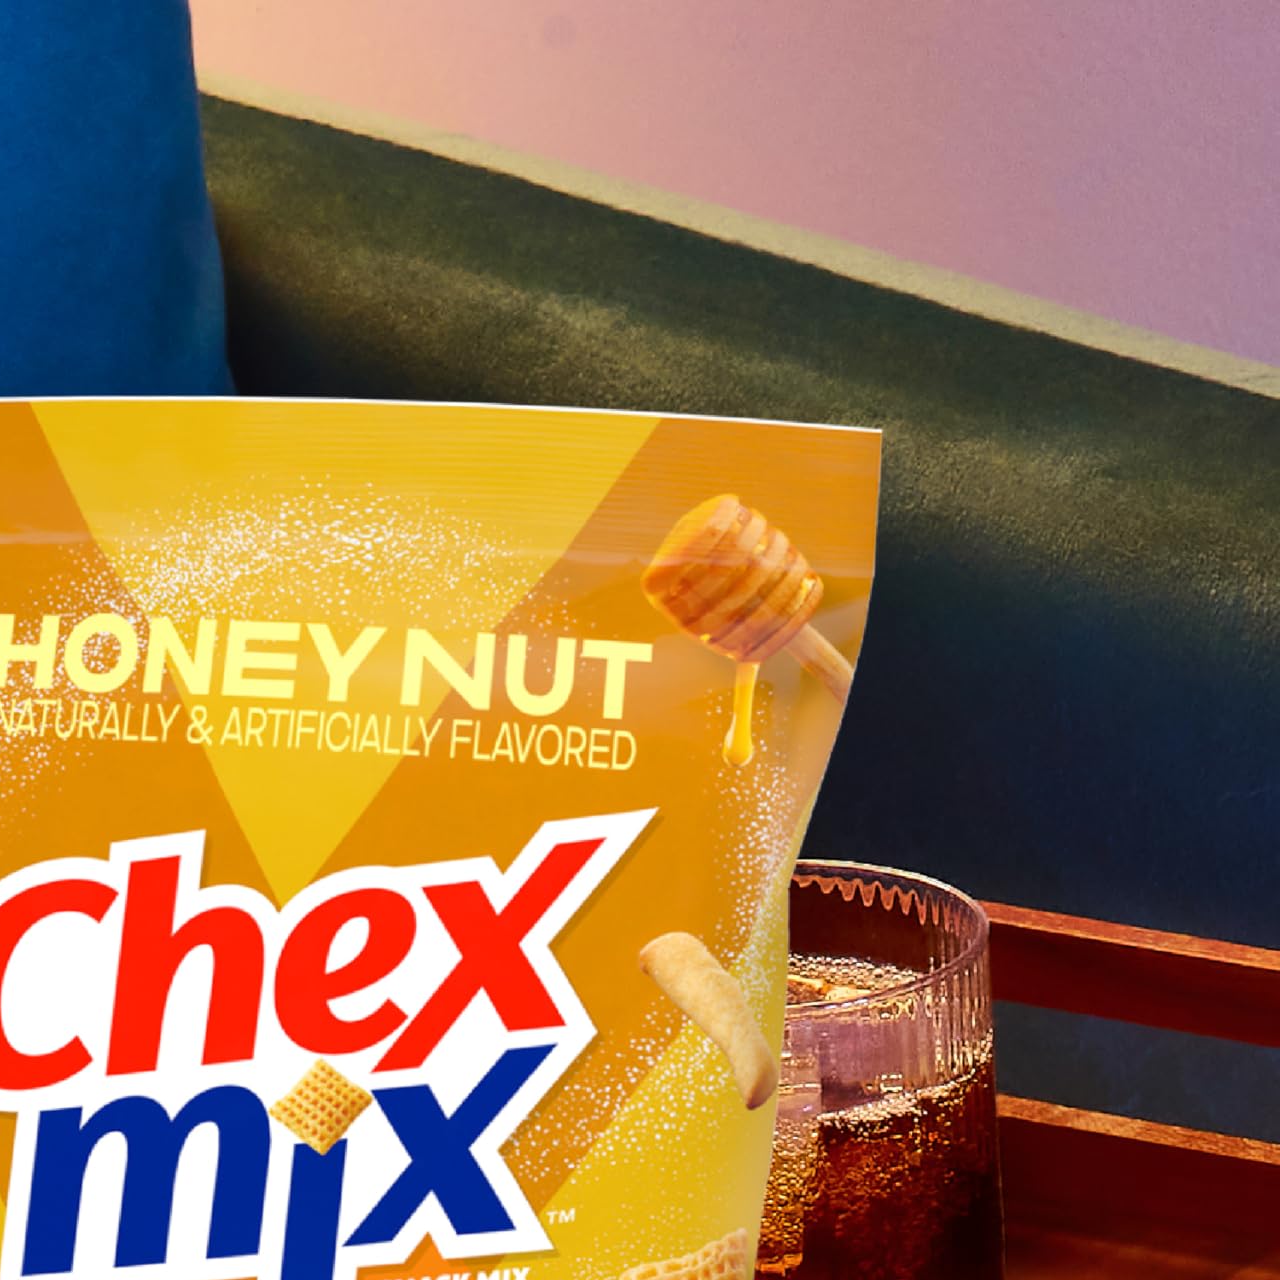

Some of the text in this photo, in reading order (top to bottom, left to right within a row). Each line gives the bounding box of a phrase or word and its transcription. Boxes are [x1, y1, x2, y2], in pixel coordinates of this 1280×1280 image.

[400, 628, 653, 720] NUT
[186, 706, 214, 745] &
[219, 707, 445, 758] ARTIFICIALLY
[449, 718, 637, 771] FLAVORED
